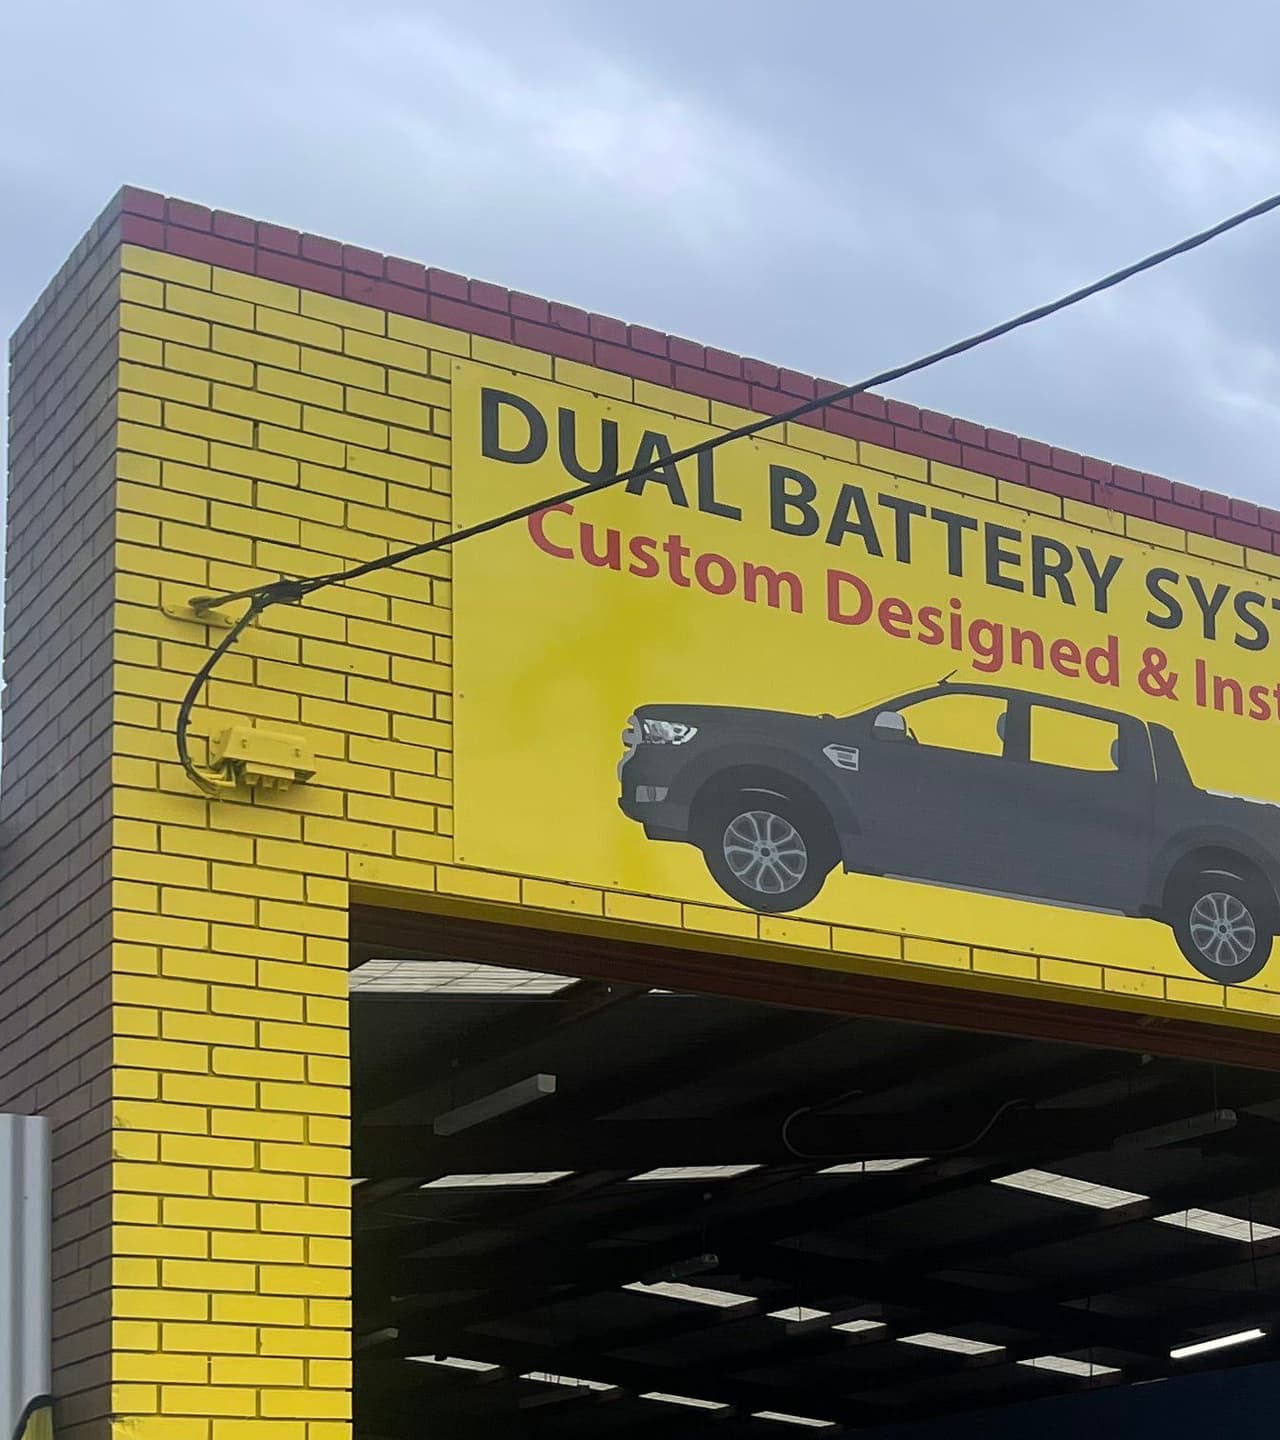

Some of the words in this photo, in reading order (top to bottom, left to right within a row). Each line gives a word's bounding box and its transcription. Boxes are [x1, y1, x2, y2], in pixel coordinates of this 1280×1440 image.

[481, 388, 742, 520] DUAL
[770, 465, 1123, 614] BATTERY
[527, 503, 804, 614] Custom
[827, 570, 1120, 688] Designed
[1137, 648, 1180, 699] &
